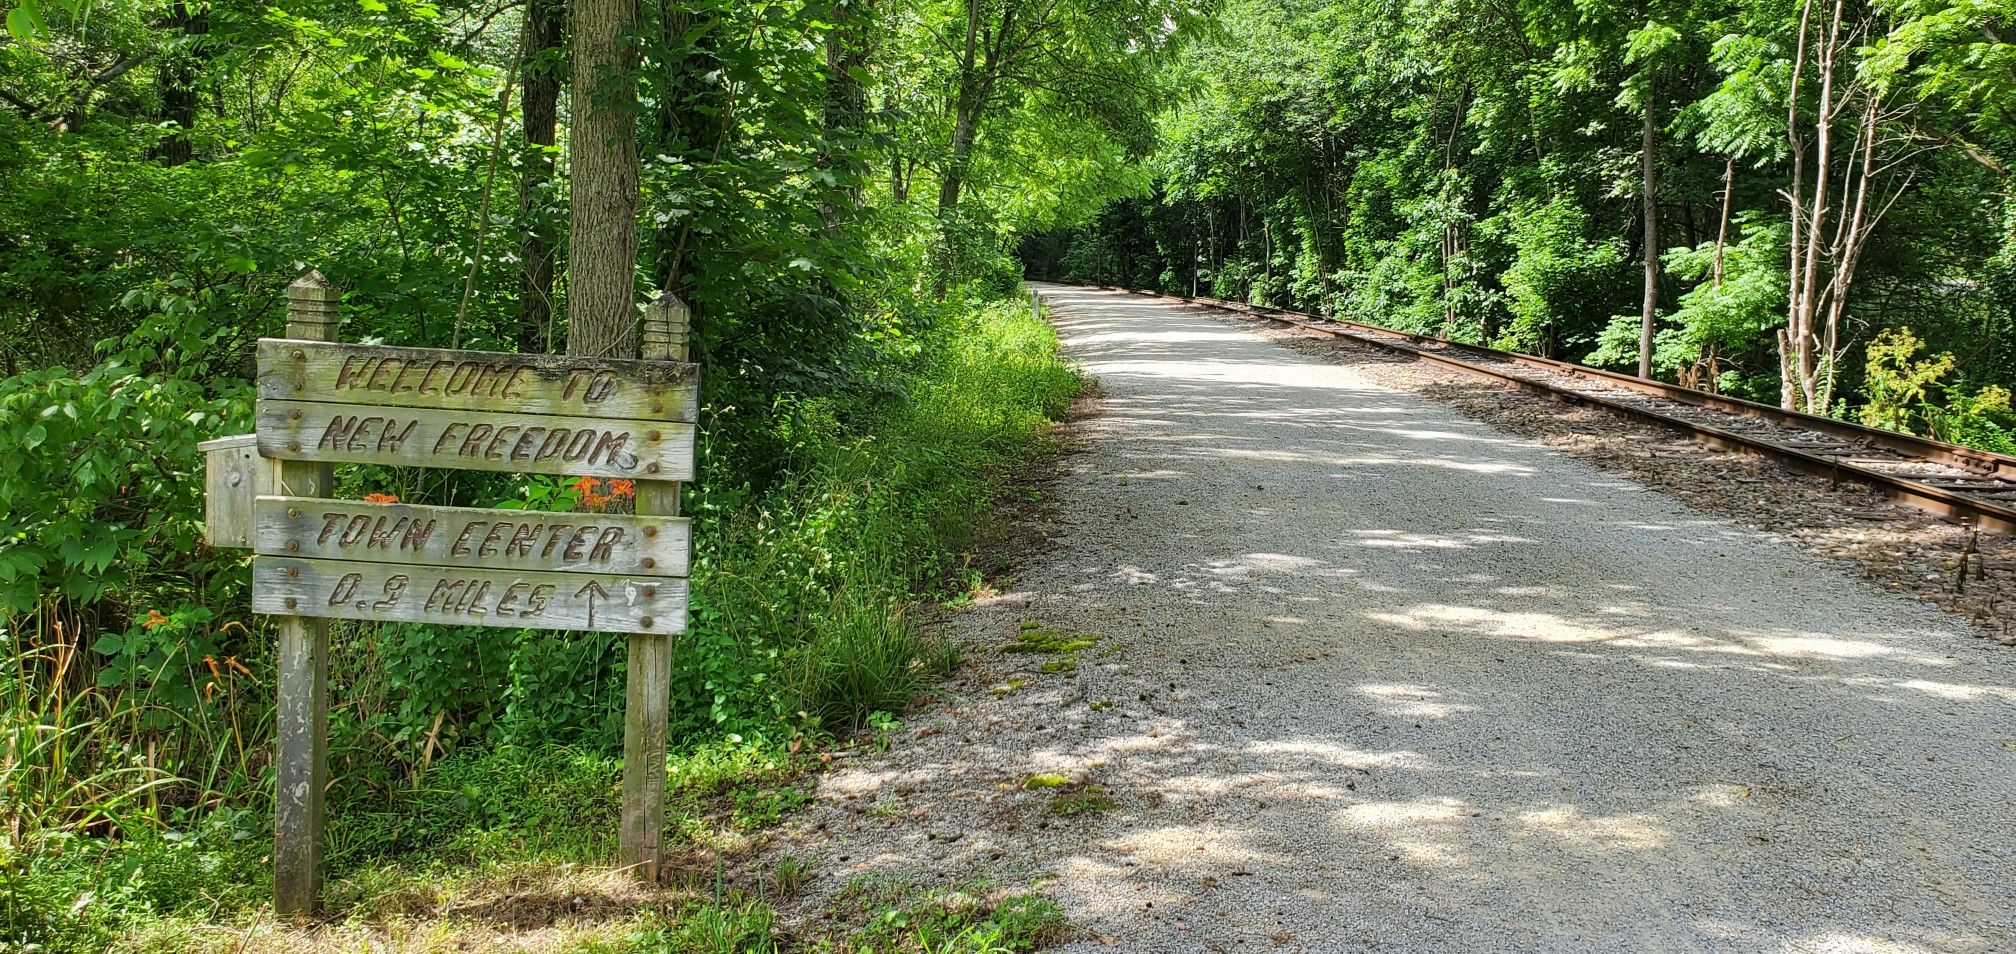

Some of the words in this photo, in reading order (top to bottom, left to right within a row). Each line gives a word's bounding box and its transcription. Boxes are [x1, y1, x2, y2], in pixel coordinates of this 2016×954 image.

[335, 355, 538, 400] WELCOME
[562, 367, 619, 404] TO
[318, 415, 419, 453] NEW
[432, 423, 630, 466] FREEDOM
[317, 513, 437, 552] TOWN
[451, 521, 625, 563] CENTER
[328, 573, 409, 612] 0.9
[424, 576, 556, 618] MILES
